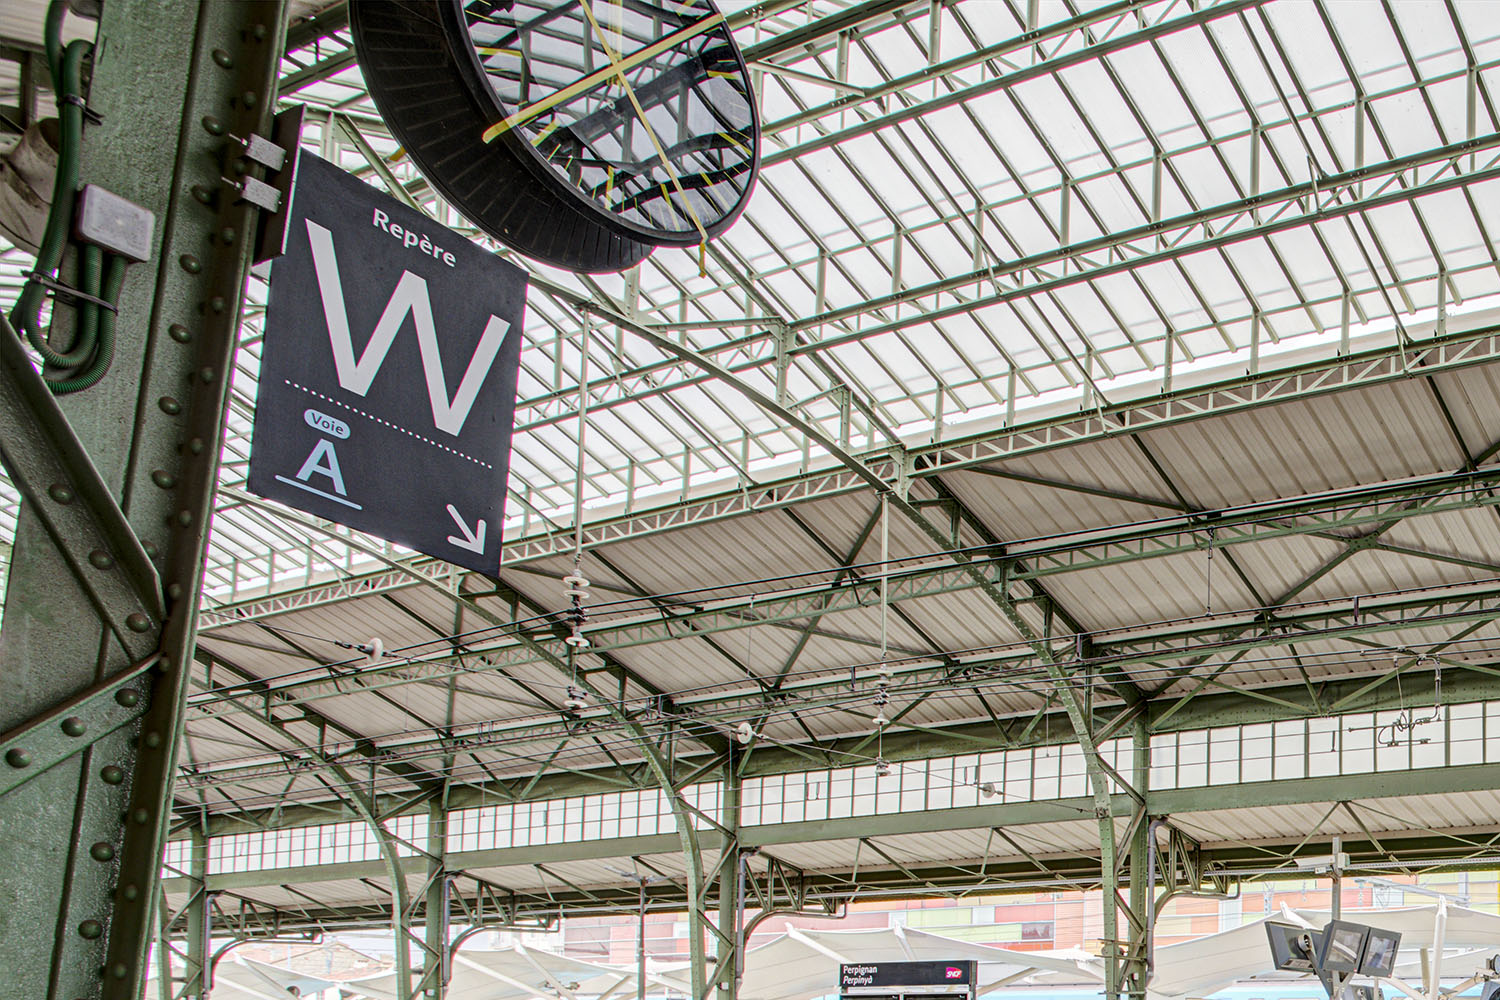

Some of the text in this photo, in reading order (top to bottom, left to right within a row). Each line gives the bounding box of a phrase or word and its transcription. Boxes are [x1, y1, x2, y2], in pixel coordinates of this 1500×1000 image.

[372, 207, 457, 268] Repère
[304, 217, 512, 438] W
[311, 411, 344, 435] Voie
[295, 437, 348, 497] A
[843, 965, 878, 976] Perpignan
